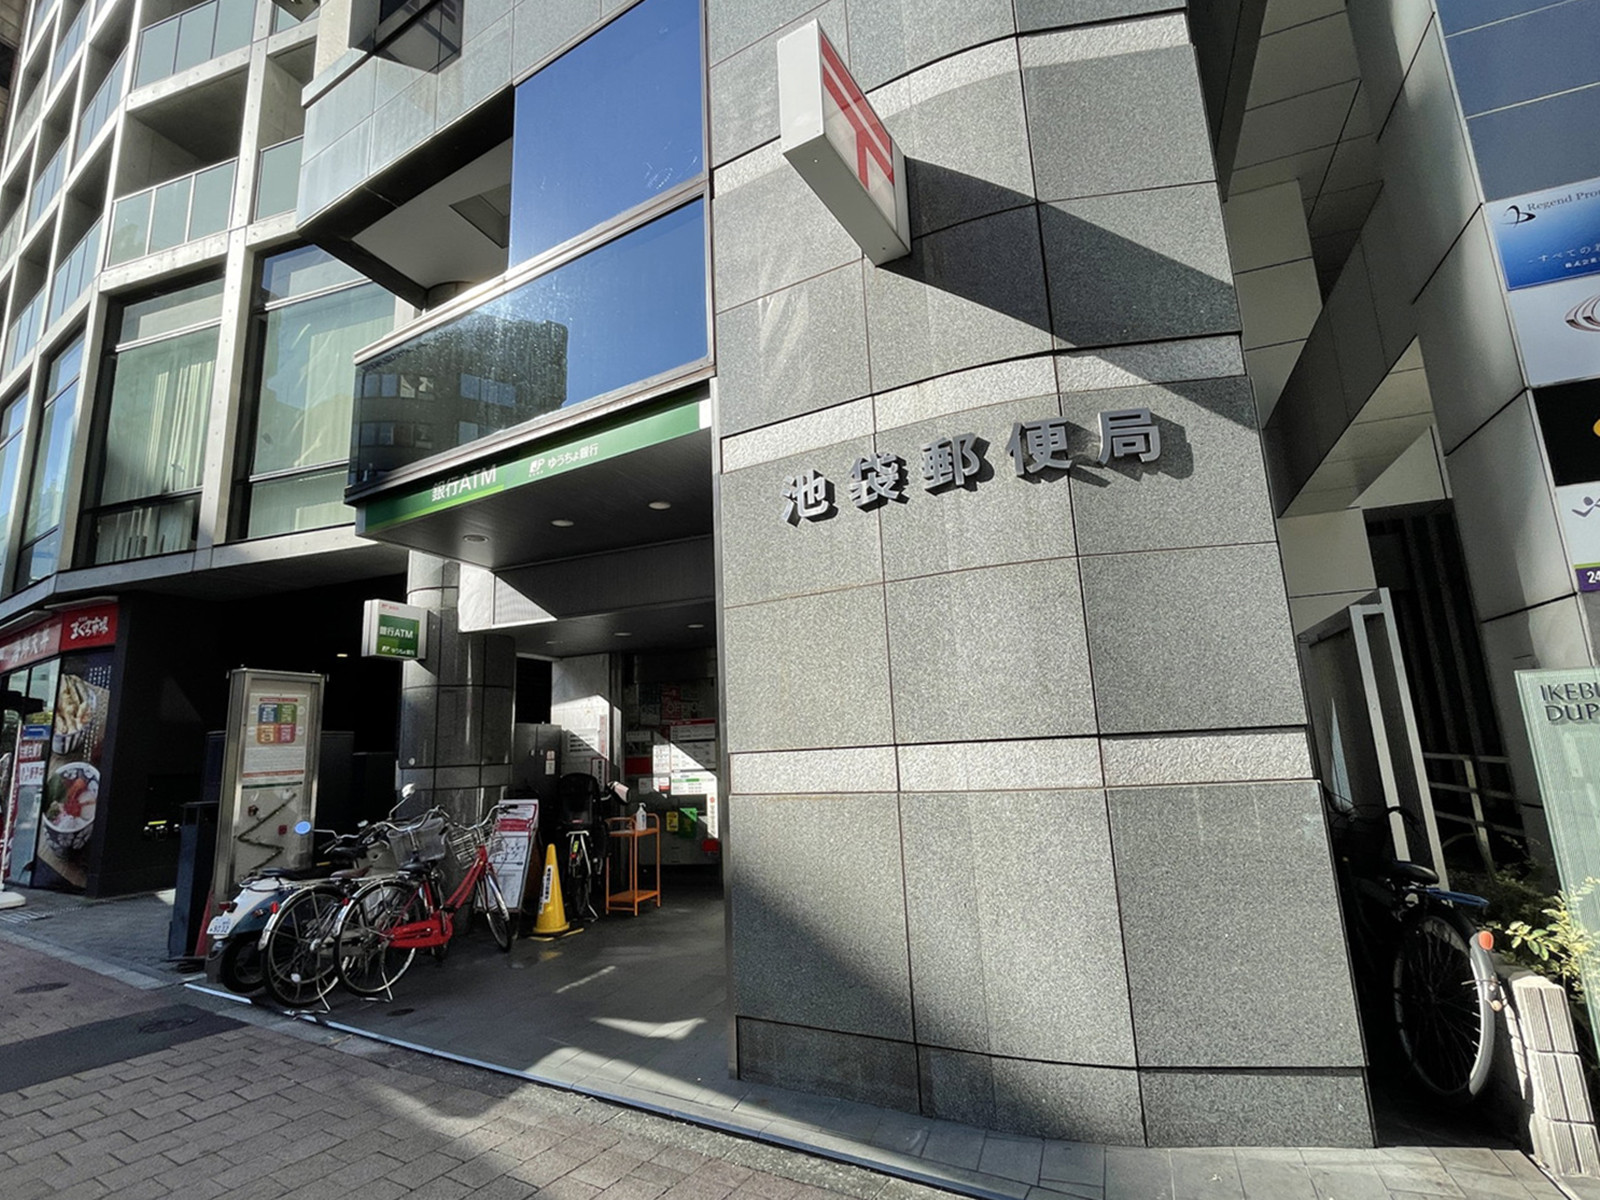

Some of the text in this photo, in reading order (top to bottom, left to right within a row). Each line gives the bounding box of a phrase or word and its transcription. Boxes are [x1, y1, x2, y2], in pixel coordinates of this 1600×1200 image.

[1527, 189, 1600, 211] Regend Pro
[547, 442, 599, 470] ゆうちょ銀行
[781, 407, 1162, 524] 池袋郵便局
[431, 464, 498, 502] 銀行ATM
[379, 626, 414, 639] 銀行ATM
